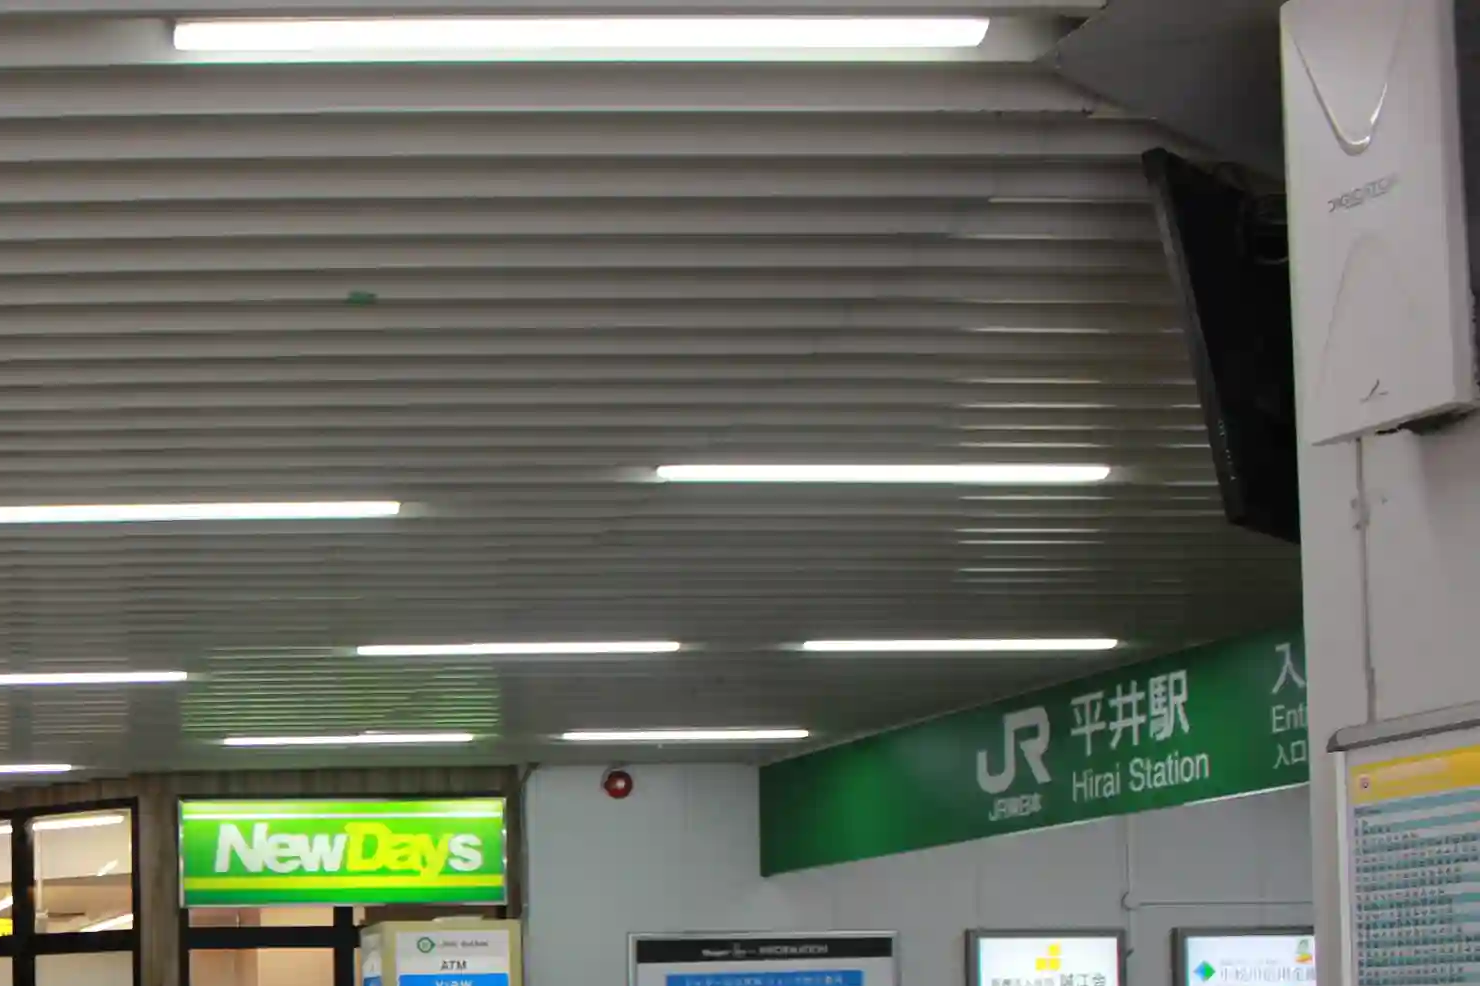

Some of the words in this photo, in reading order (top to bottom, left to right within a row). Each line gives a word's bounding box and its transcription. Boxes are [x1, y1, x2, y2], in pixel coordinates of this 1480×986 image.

[1070, 669, 1190, 757] 平井駅
[976, 705, 1052, 795] JR
[1072, 762, 1121, 803] Hirai
[1128, 750, 1210, 792] Station
[1272, 739, 1307, 770] 入口
[214, 821, 484, 882] NewDays
[440, 959, 468, 971] ATM
